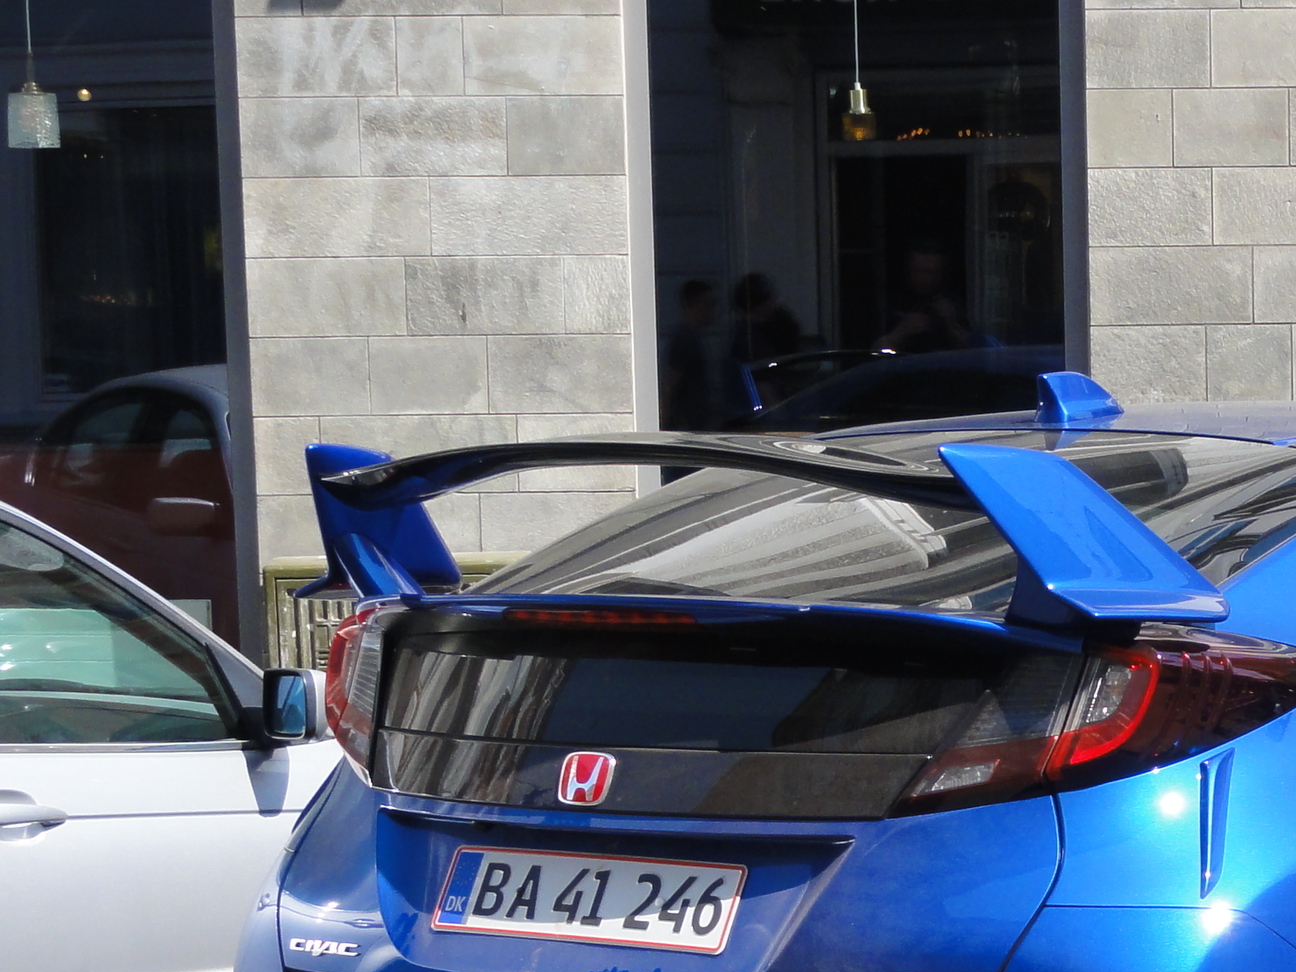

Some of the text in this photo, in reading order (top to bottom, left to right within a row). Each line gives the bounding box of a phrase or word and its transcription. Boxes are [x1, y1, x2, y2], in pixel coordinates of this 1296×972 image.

[445, 895, 464, 912] DK
[471, 862, 725, 936] BA 41 246
[289, 937, 361, 957] CIVIC
